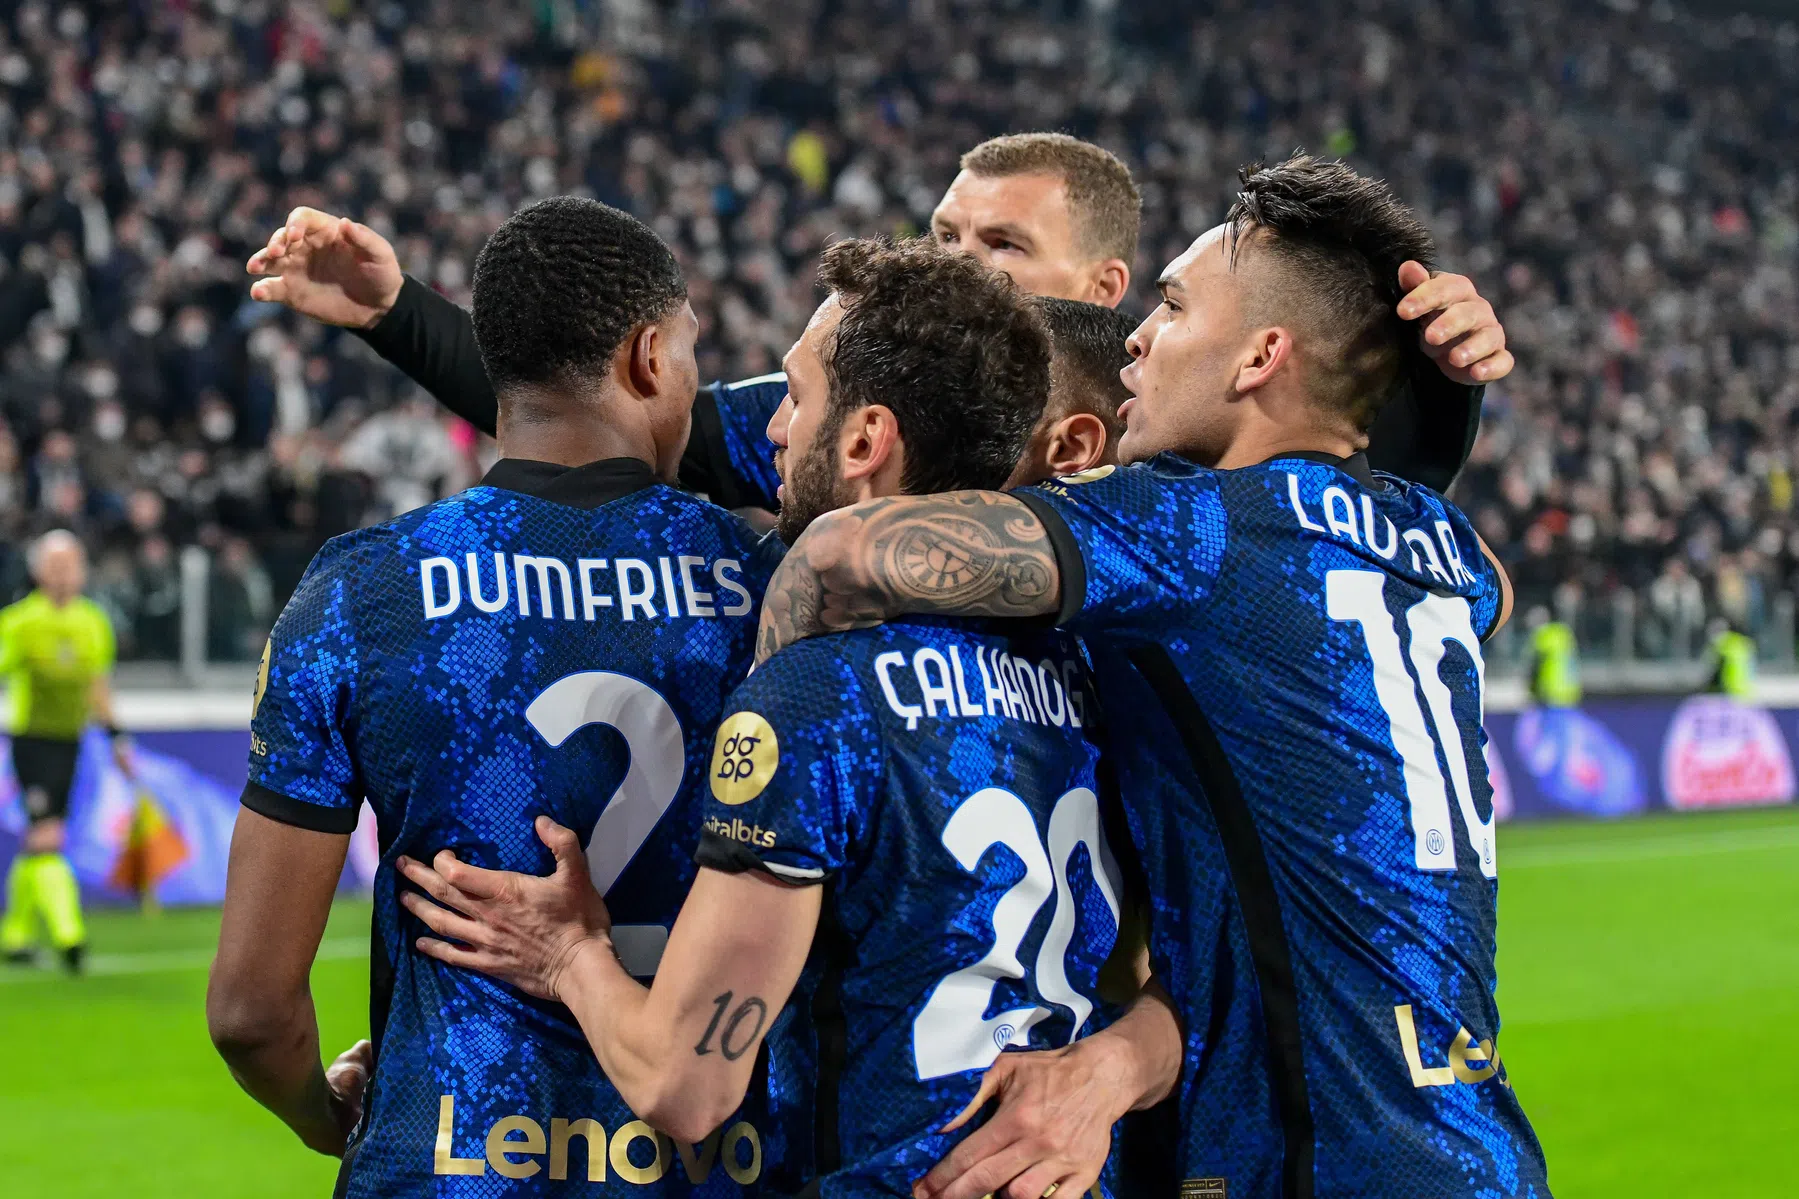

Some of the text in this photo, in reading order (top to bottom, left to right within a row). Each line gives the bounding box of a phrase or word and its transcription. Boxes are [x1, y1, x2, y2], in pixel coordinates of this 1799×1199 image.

[419, 552, 752, 621] DUMFRIES
[1326, 569, 1498, 880] 10
[525, 670, 685, 976] 2
[694, 990, 767, 1061] 10
[911, 785, 1122, 1082] 20
[433, 1094, 762, 1185] Lenovo
